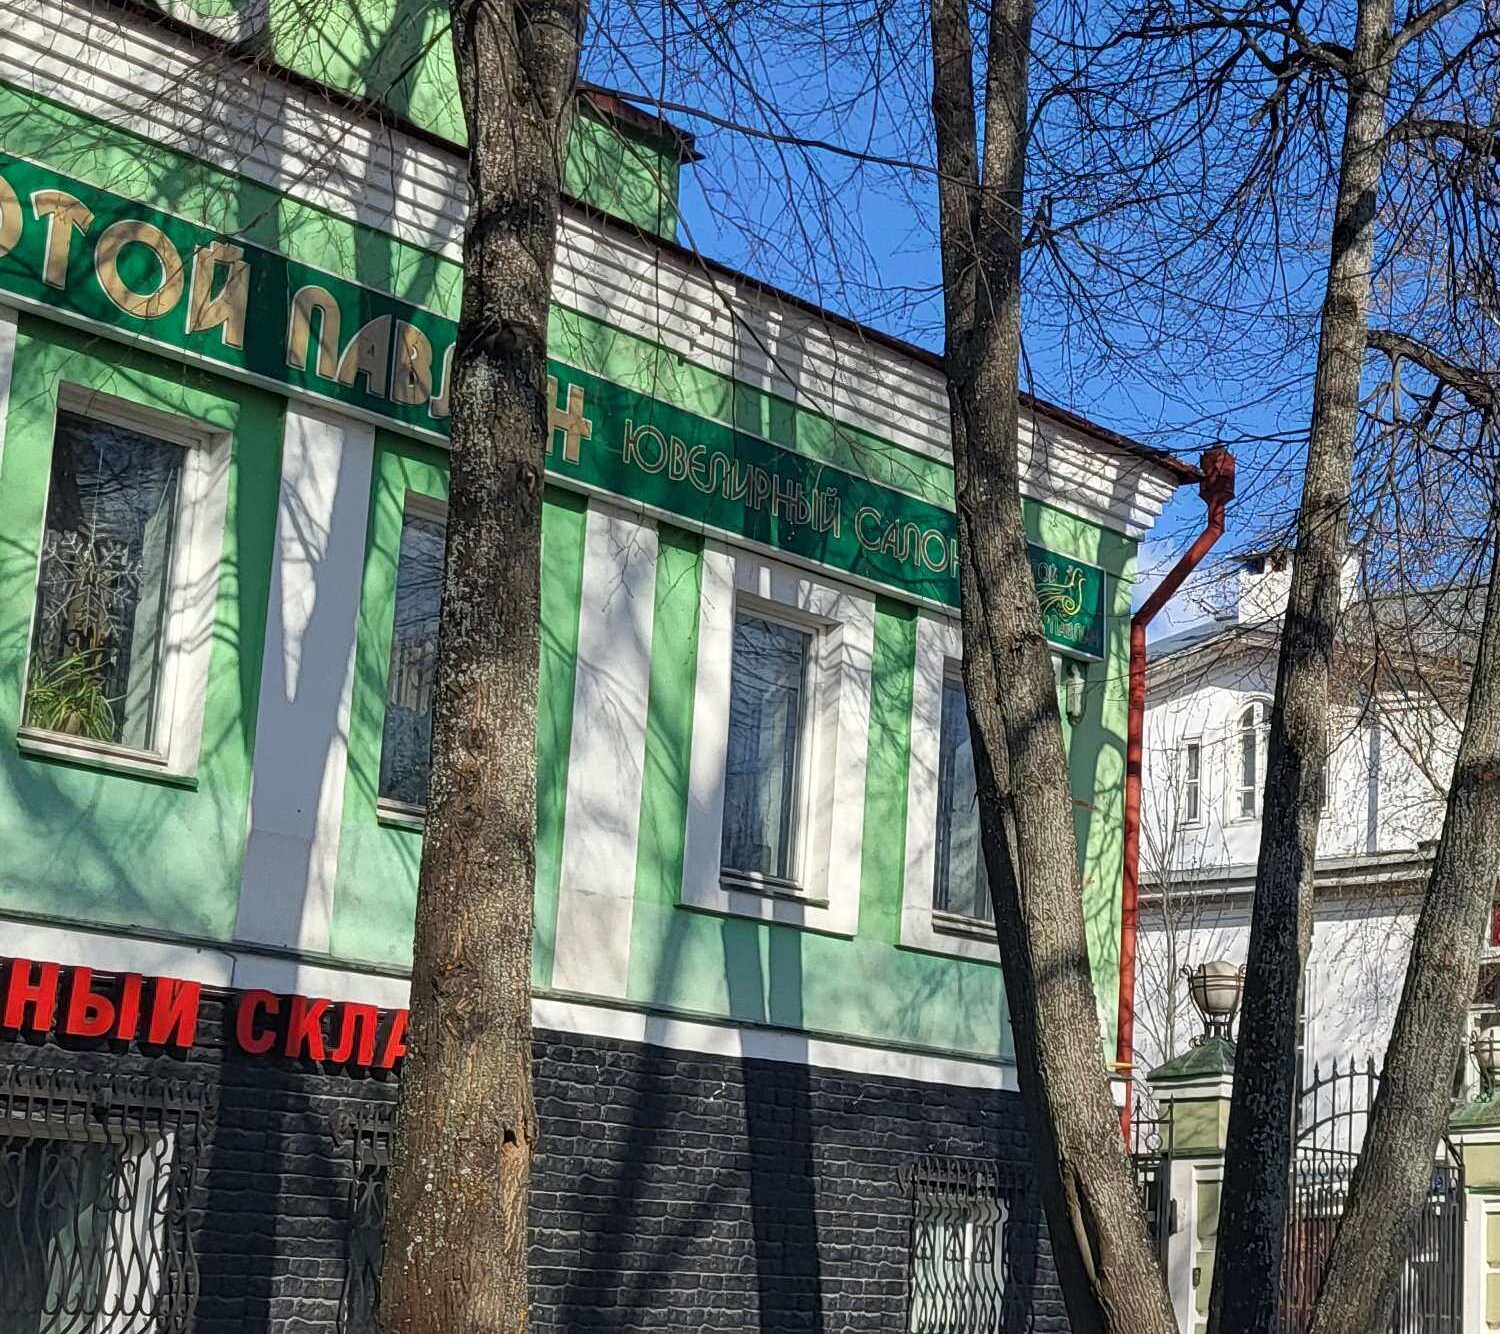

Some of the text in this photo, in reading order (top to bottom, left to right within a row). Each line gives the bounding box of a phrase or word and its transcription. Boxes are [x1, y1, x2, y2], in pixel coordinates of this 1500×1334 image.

[0, 175, 250, 351] ТОЙ
[286, 284, 592, 465] ПАВН
[622, 418, 841, 539] ЮВЕЛИРНЫЙ
